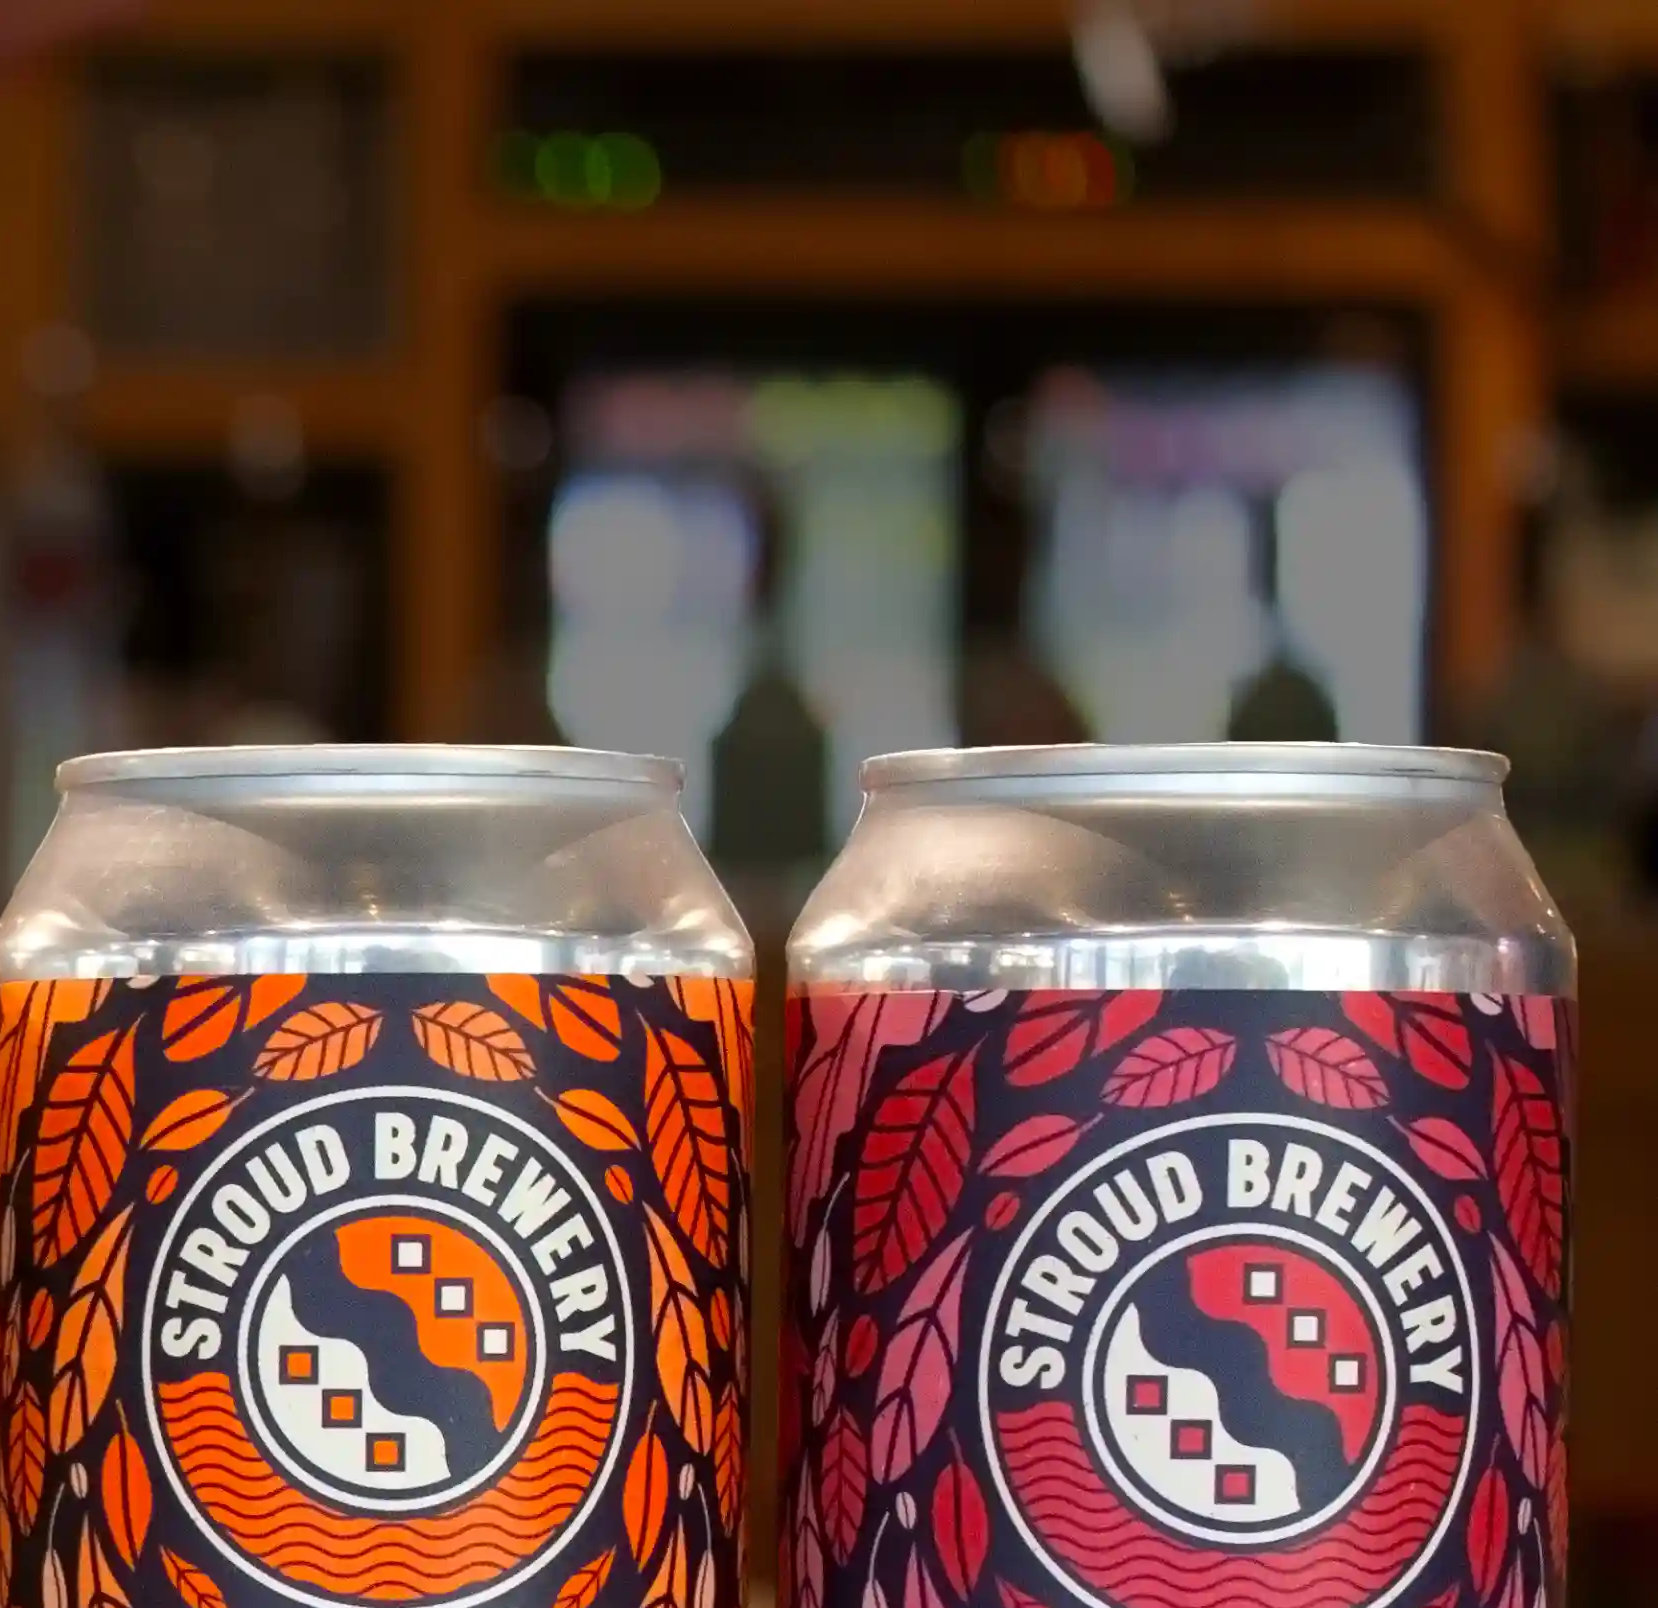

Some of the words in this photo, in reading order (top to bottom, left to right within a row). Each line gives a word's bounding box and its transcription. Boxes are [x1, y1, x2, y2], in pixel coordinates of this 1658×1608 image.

[160, 1124, 351, 1360] STROUD
[374, 1112, 617, 1362] BREWERY
[999, 1150, 1203, 1390] STROUD
[1226, 1138, 1463, 1394] BREWERY
